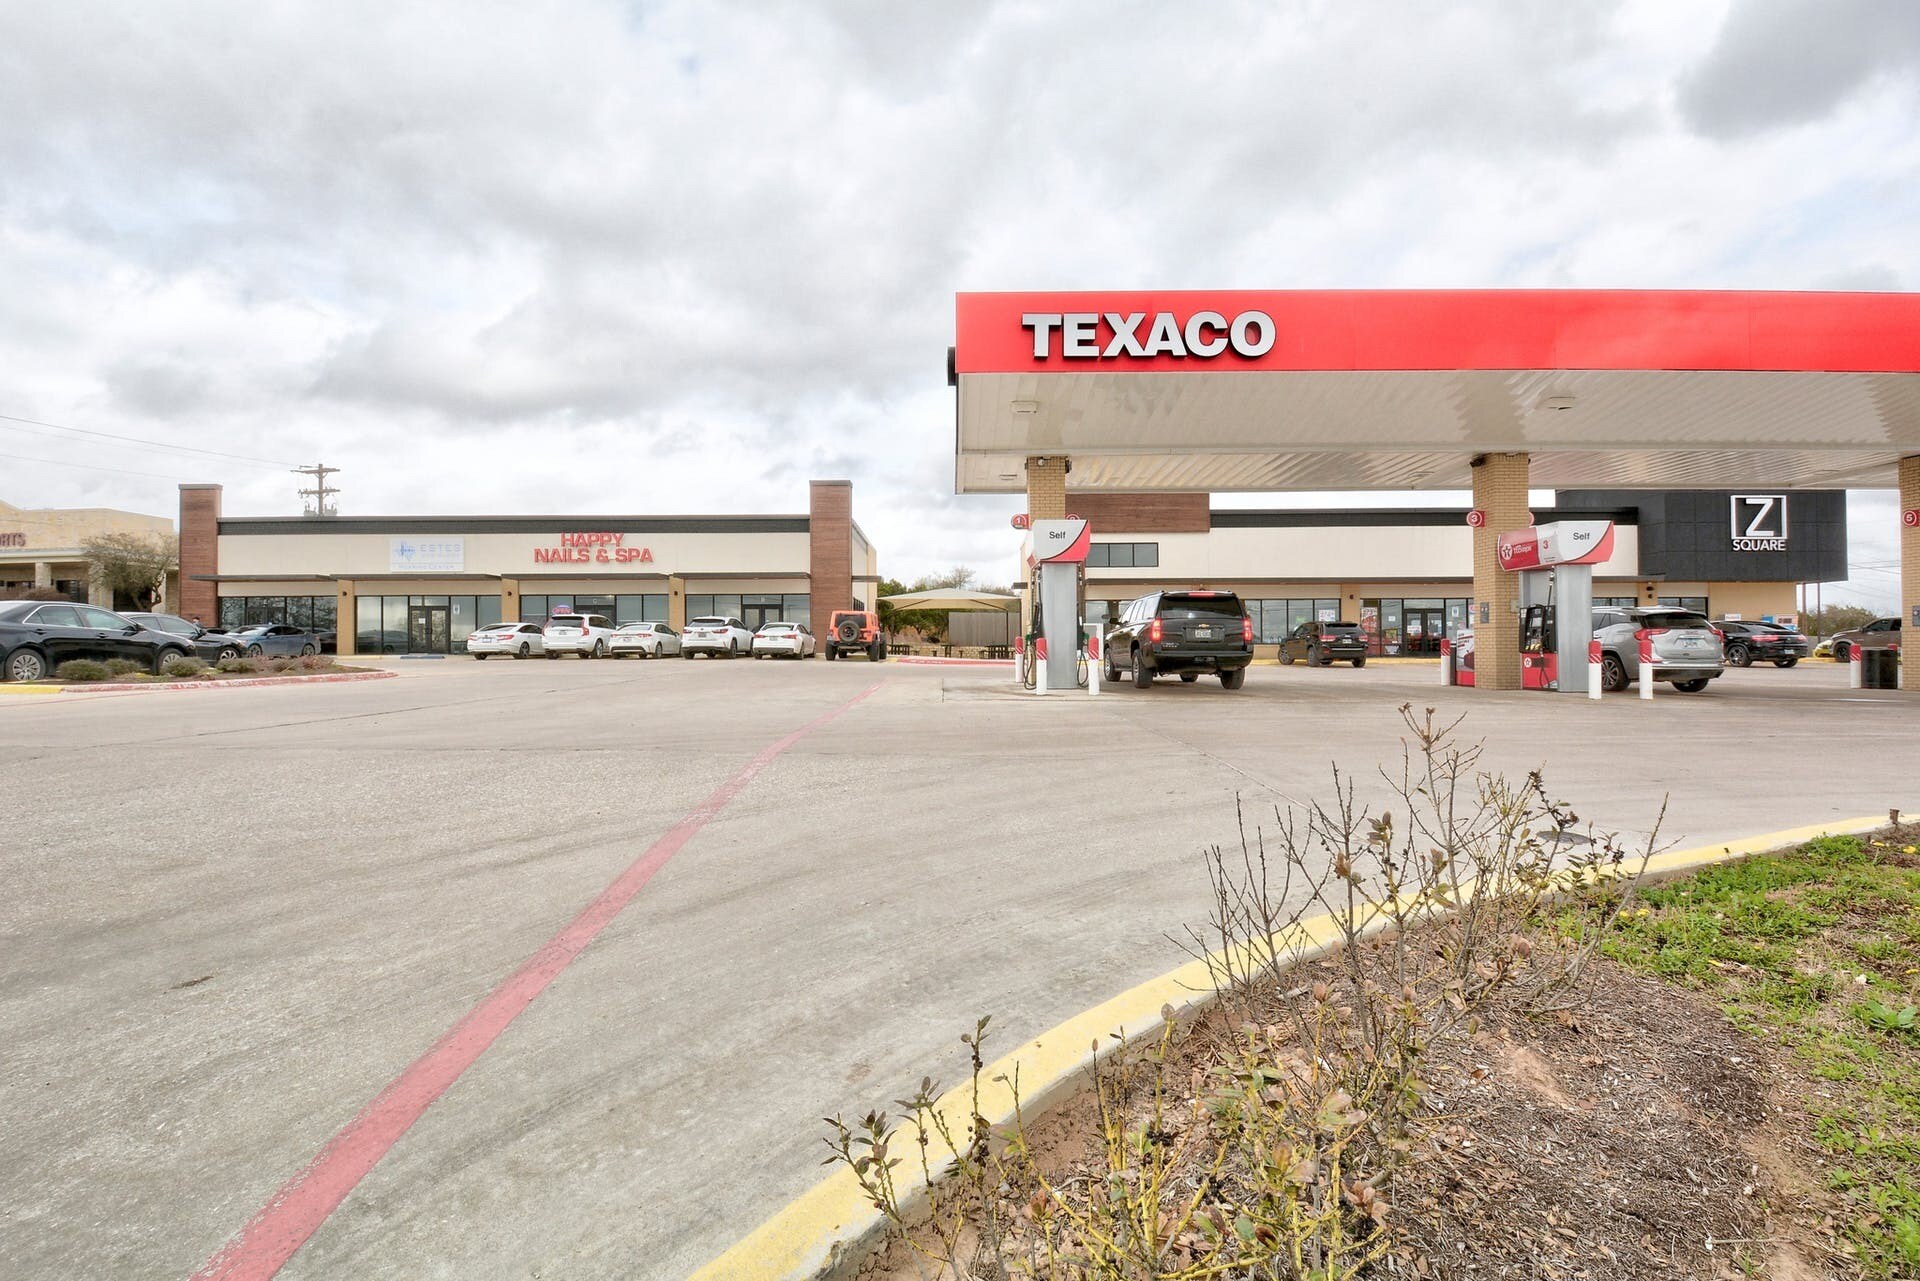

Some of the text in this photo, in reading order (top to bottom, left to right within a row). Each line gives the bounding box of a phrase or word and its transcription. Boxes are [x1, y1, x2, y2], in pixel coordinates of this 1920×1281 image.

[1022, 311, 1277, 358] TEXACO
[1471, 514, 1478, 522] 3
[1745, 499, 1774, 536] Z
[1906, 513, 1913, 522] 5
[0, 532, 26, 547] RTS
[560, 532, 624, 547] HAPPY
[1049, 531, 1066, 539] Self
[1573, 532, 1590, 540] Self
[1543, 541, 1549, 549] 3
[1732, 539, 1787, 551] SQUARE
[534, 547, 654, 563] NAILS & SPA
